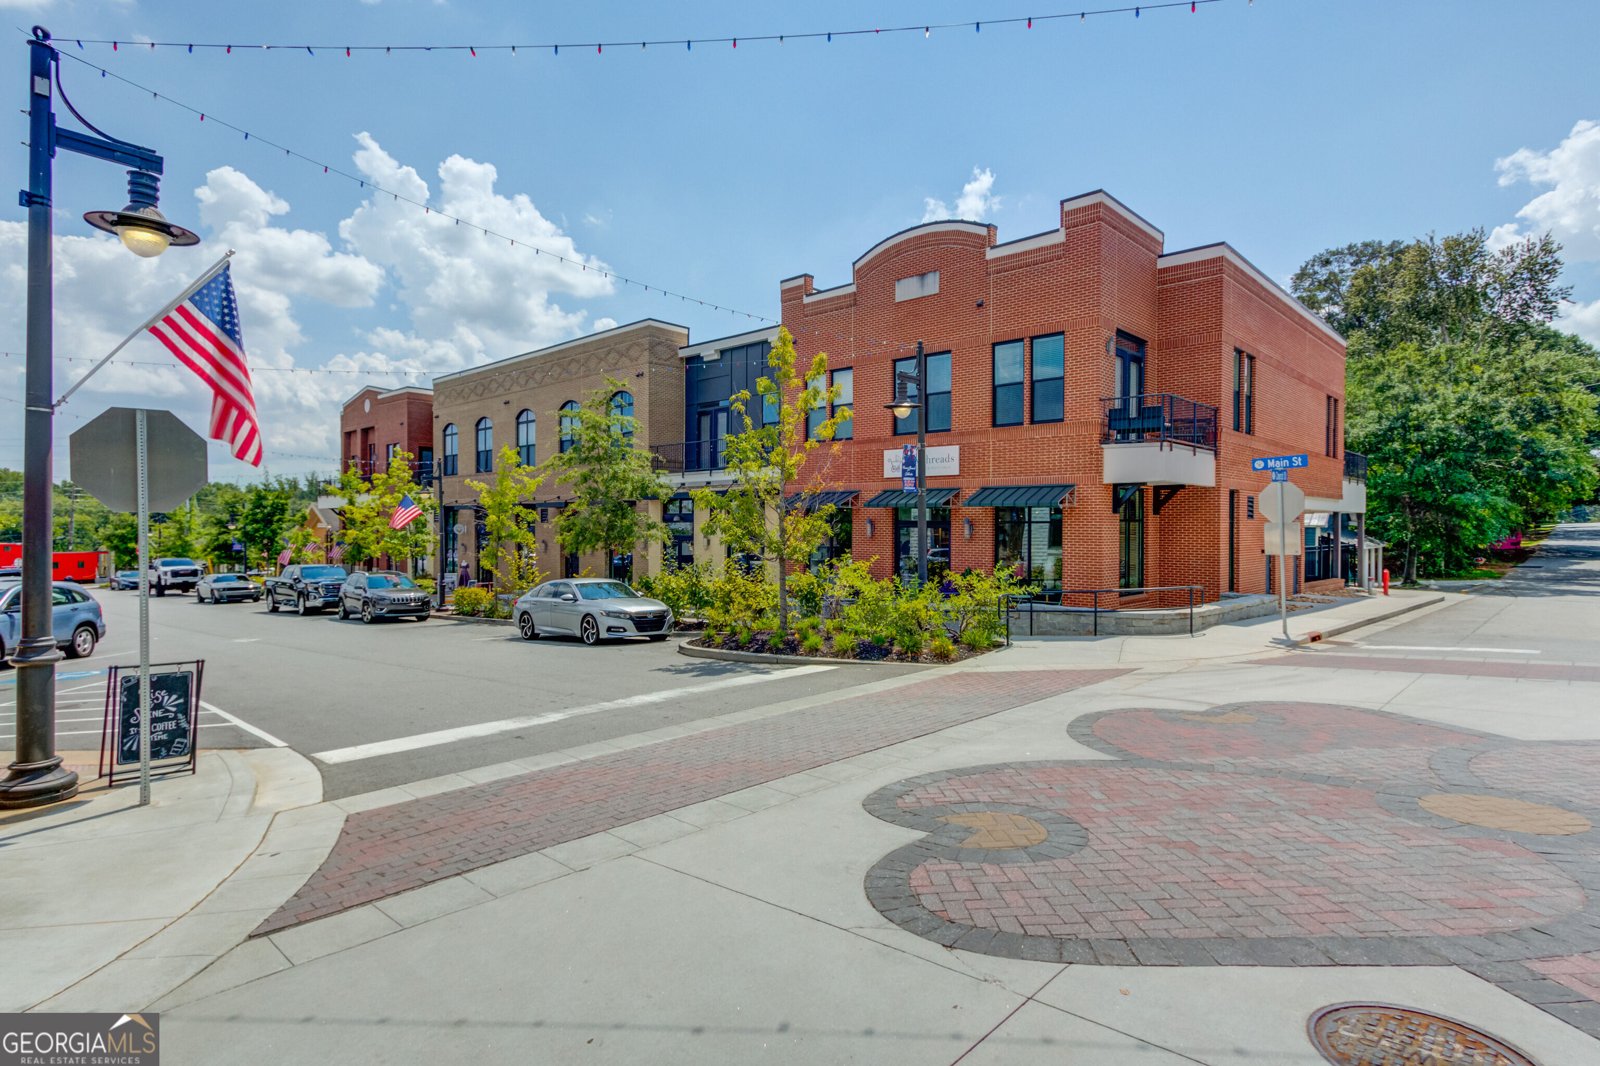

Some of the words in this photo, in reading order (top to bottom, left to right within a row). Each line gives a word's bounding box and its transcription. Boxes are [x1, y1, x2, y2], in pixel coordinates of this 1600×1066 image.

[925, 453, 955, 464] hreads
[1267, 458, 1289, 468] Main
[1292, 456, 1302, 466] St
